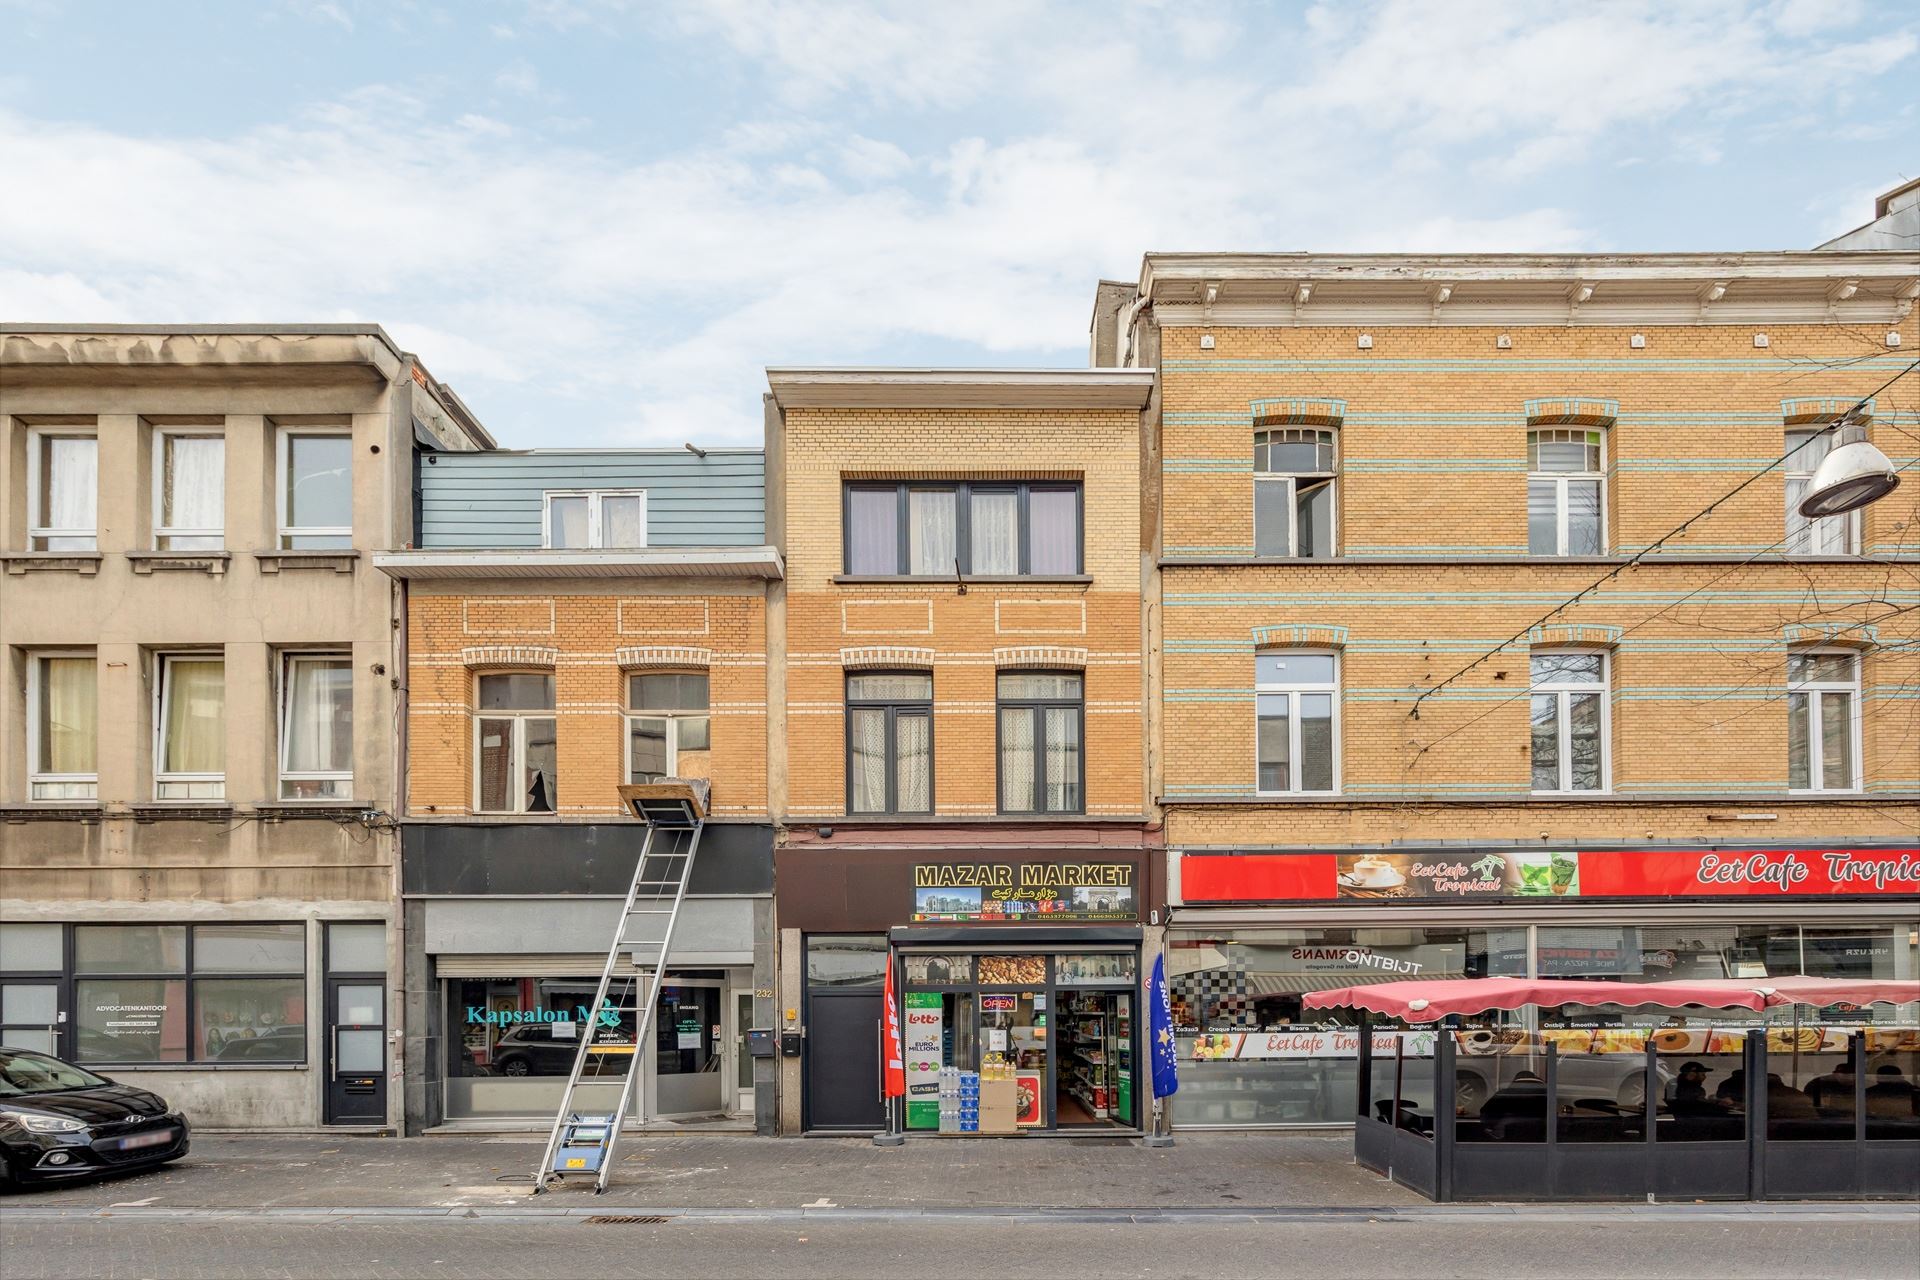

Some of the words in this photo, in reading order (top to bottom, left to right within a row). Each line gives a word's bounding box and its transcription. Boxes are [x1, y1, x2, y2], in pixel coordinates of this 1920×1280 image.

[915, 865, 1012, 886] MAZAR
[1021, 865, 1132, 886] MARKET
[1432, 877, 1501, 895] Tropical
[1346, 951, 1422, 975] ONTBIJT
[756, 989, 773, 998] 232
[983, 999, 1014, 1008] OPEN
[465, 1005, 569, 1028] Kapsalon
[1331, 1032, 1399, 1050] Troical
